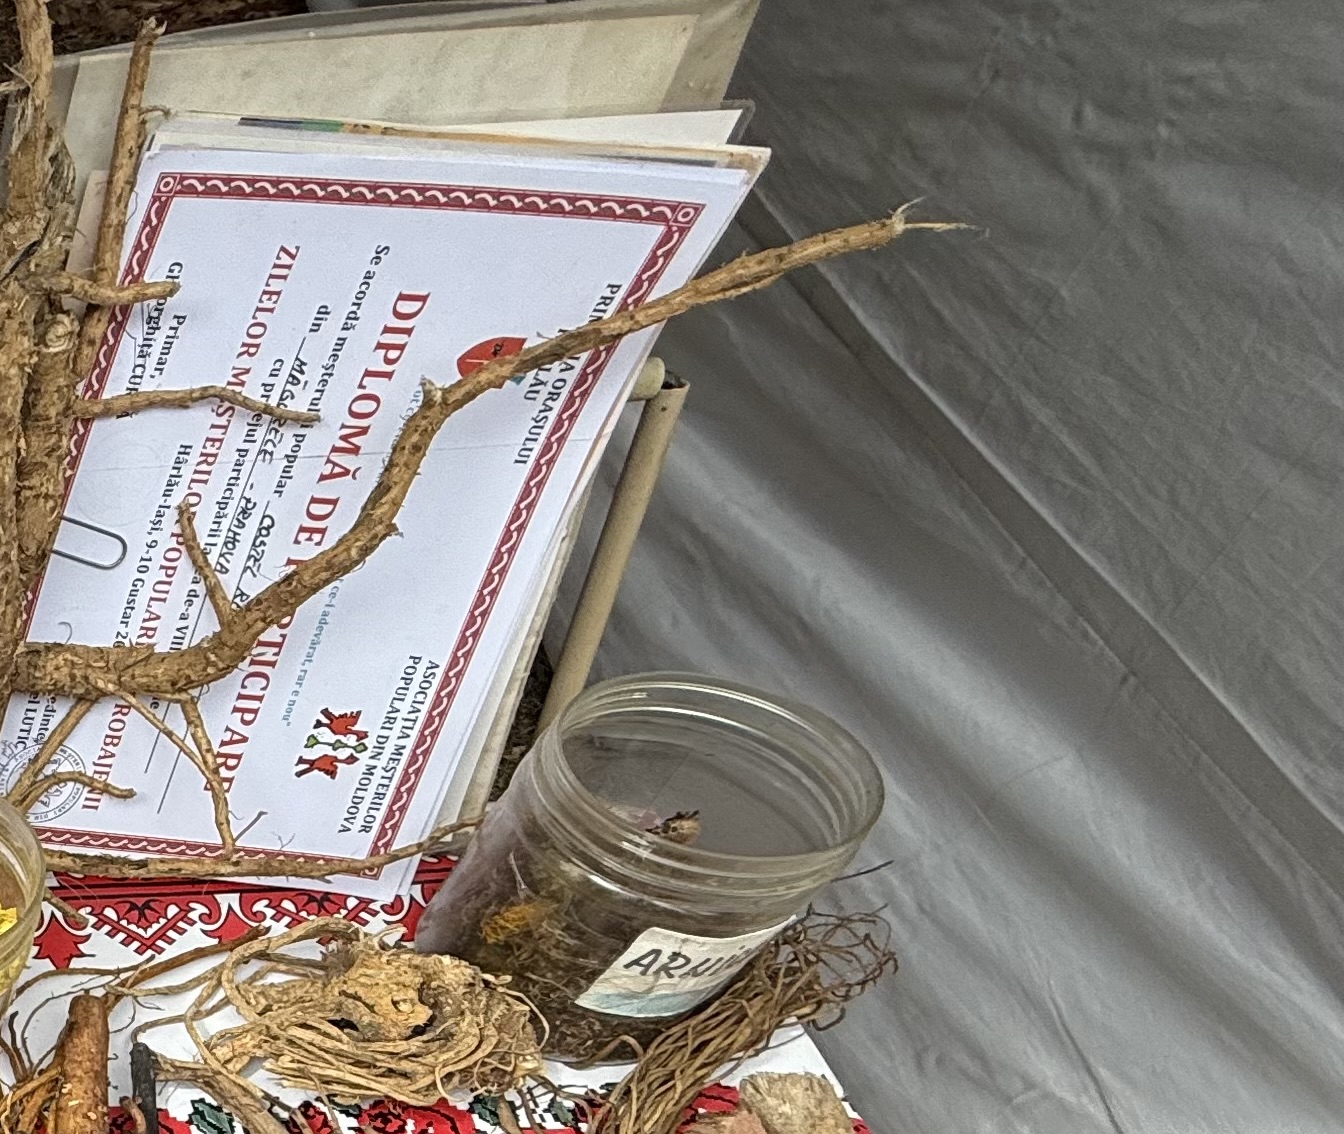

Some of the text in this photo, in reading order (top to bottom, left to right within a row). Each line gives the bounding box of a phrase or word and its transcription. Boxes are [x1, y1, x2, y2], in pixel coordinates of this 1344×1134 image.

[370, 244, 390, 266] Se
[236, 245, 300, 359] ZILELOR
[309, 304, 331, 334] din
[341, 269, 376, 331] acordă
[150, 314, 188, 379] Primar,
[268, 358, 284, 379] cu
[244, 383, 276, 444] prejul
[293, 290, 430, 547] DIPLOMĂ DE
[513, 378, 567, 465] ORAȘULUI
[273, 433, 307, 498] popular
[119, 577, 146, 626] Gustar
[337, 654, 423, 834] POPULARI DIN MOLDOVA
[358, 744, 406, 834] MEȘTERILOR
